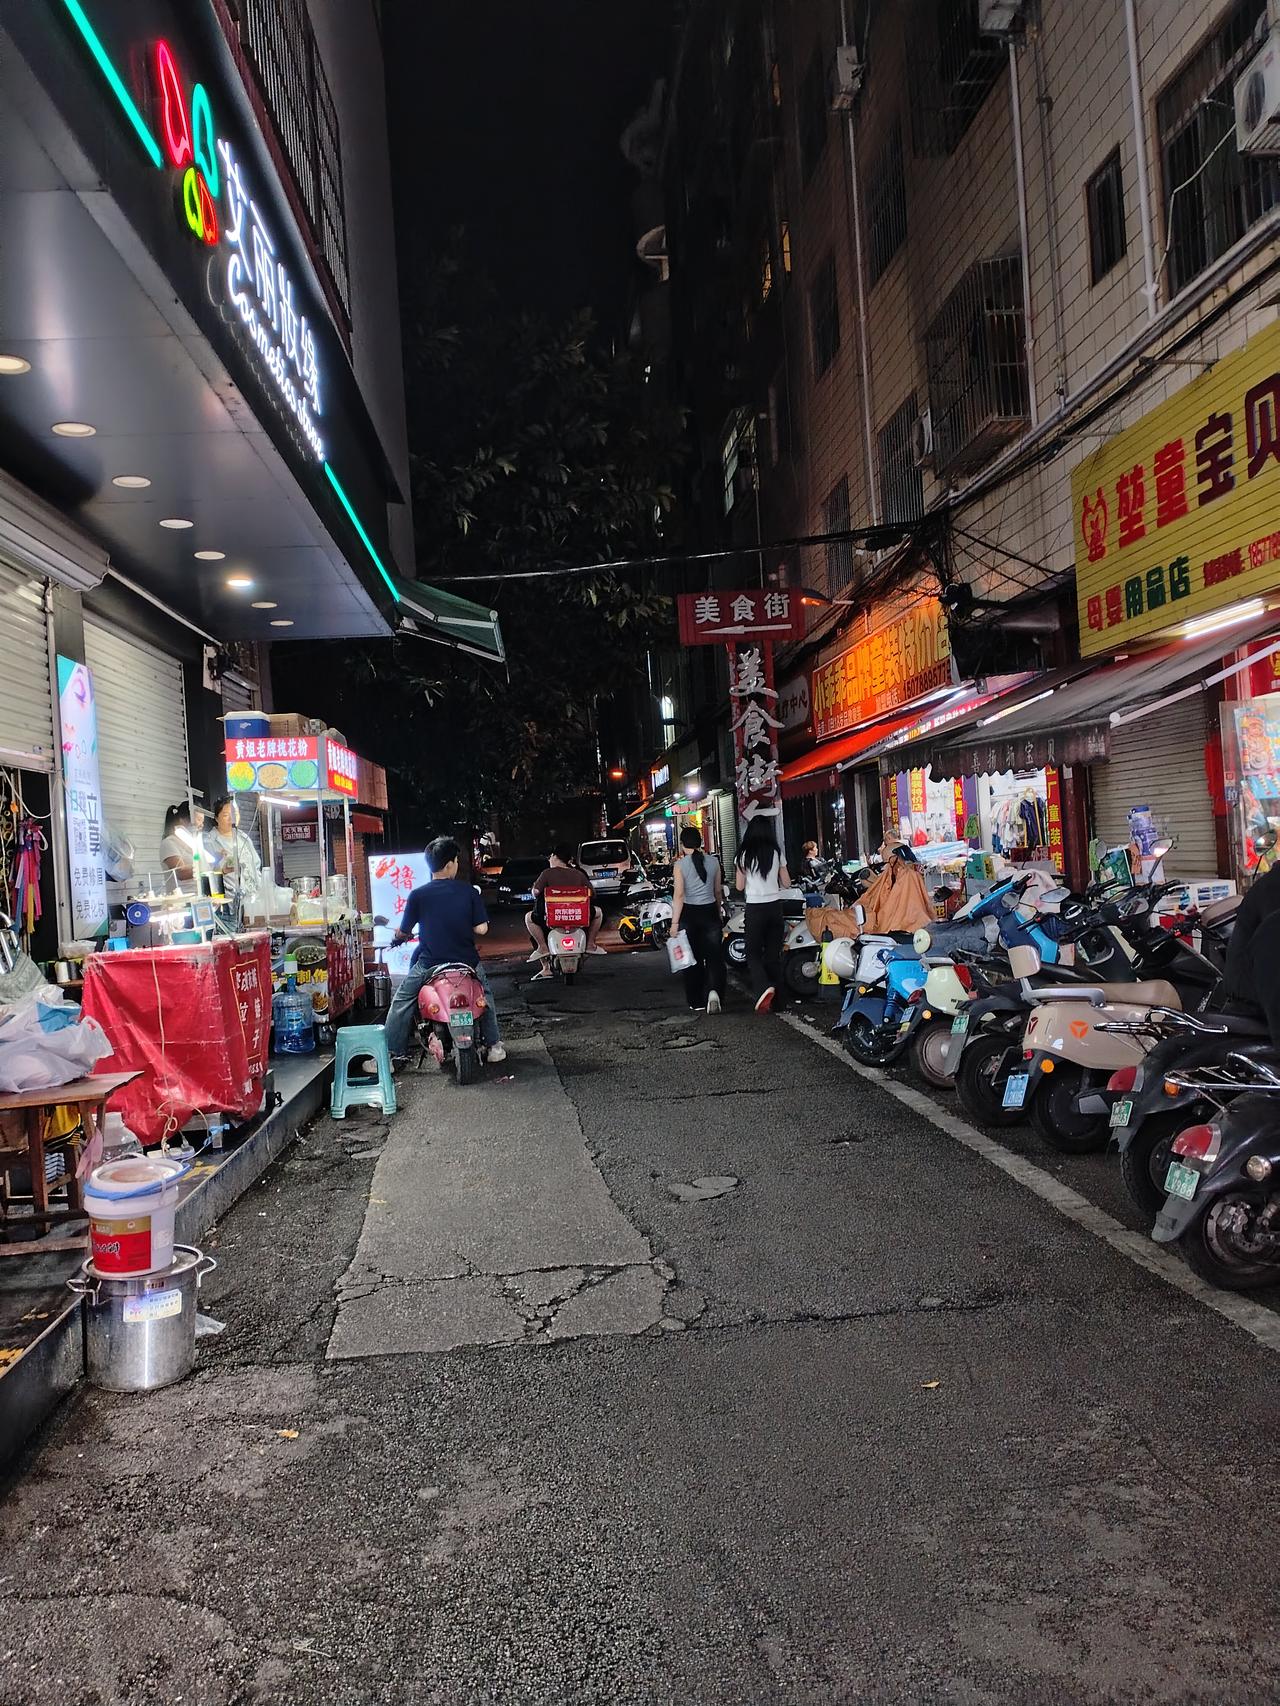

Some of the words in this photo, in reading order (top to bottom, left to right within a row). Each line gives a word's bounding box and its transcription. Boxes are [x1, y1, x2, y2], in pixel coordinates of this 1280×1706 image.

[228, 253, 297, 412] Cosmetics
[695, 592, 790, 624] 美食街
[1088, 556, 1191, 632] 母婴用品店
[728, 648, 786, 797] 美食街
